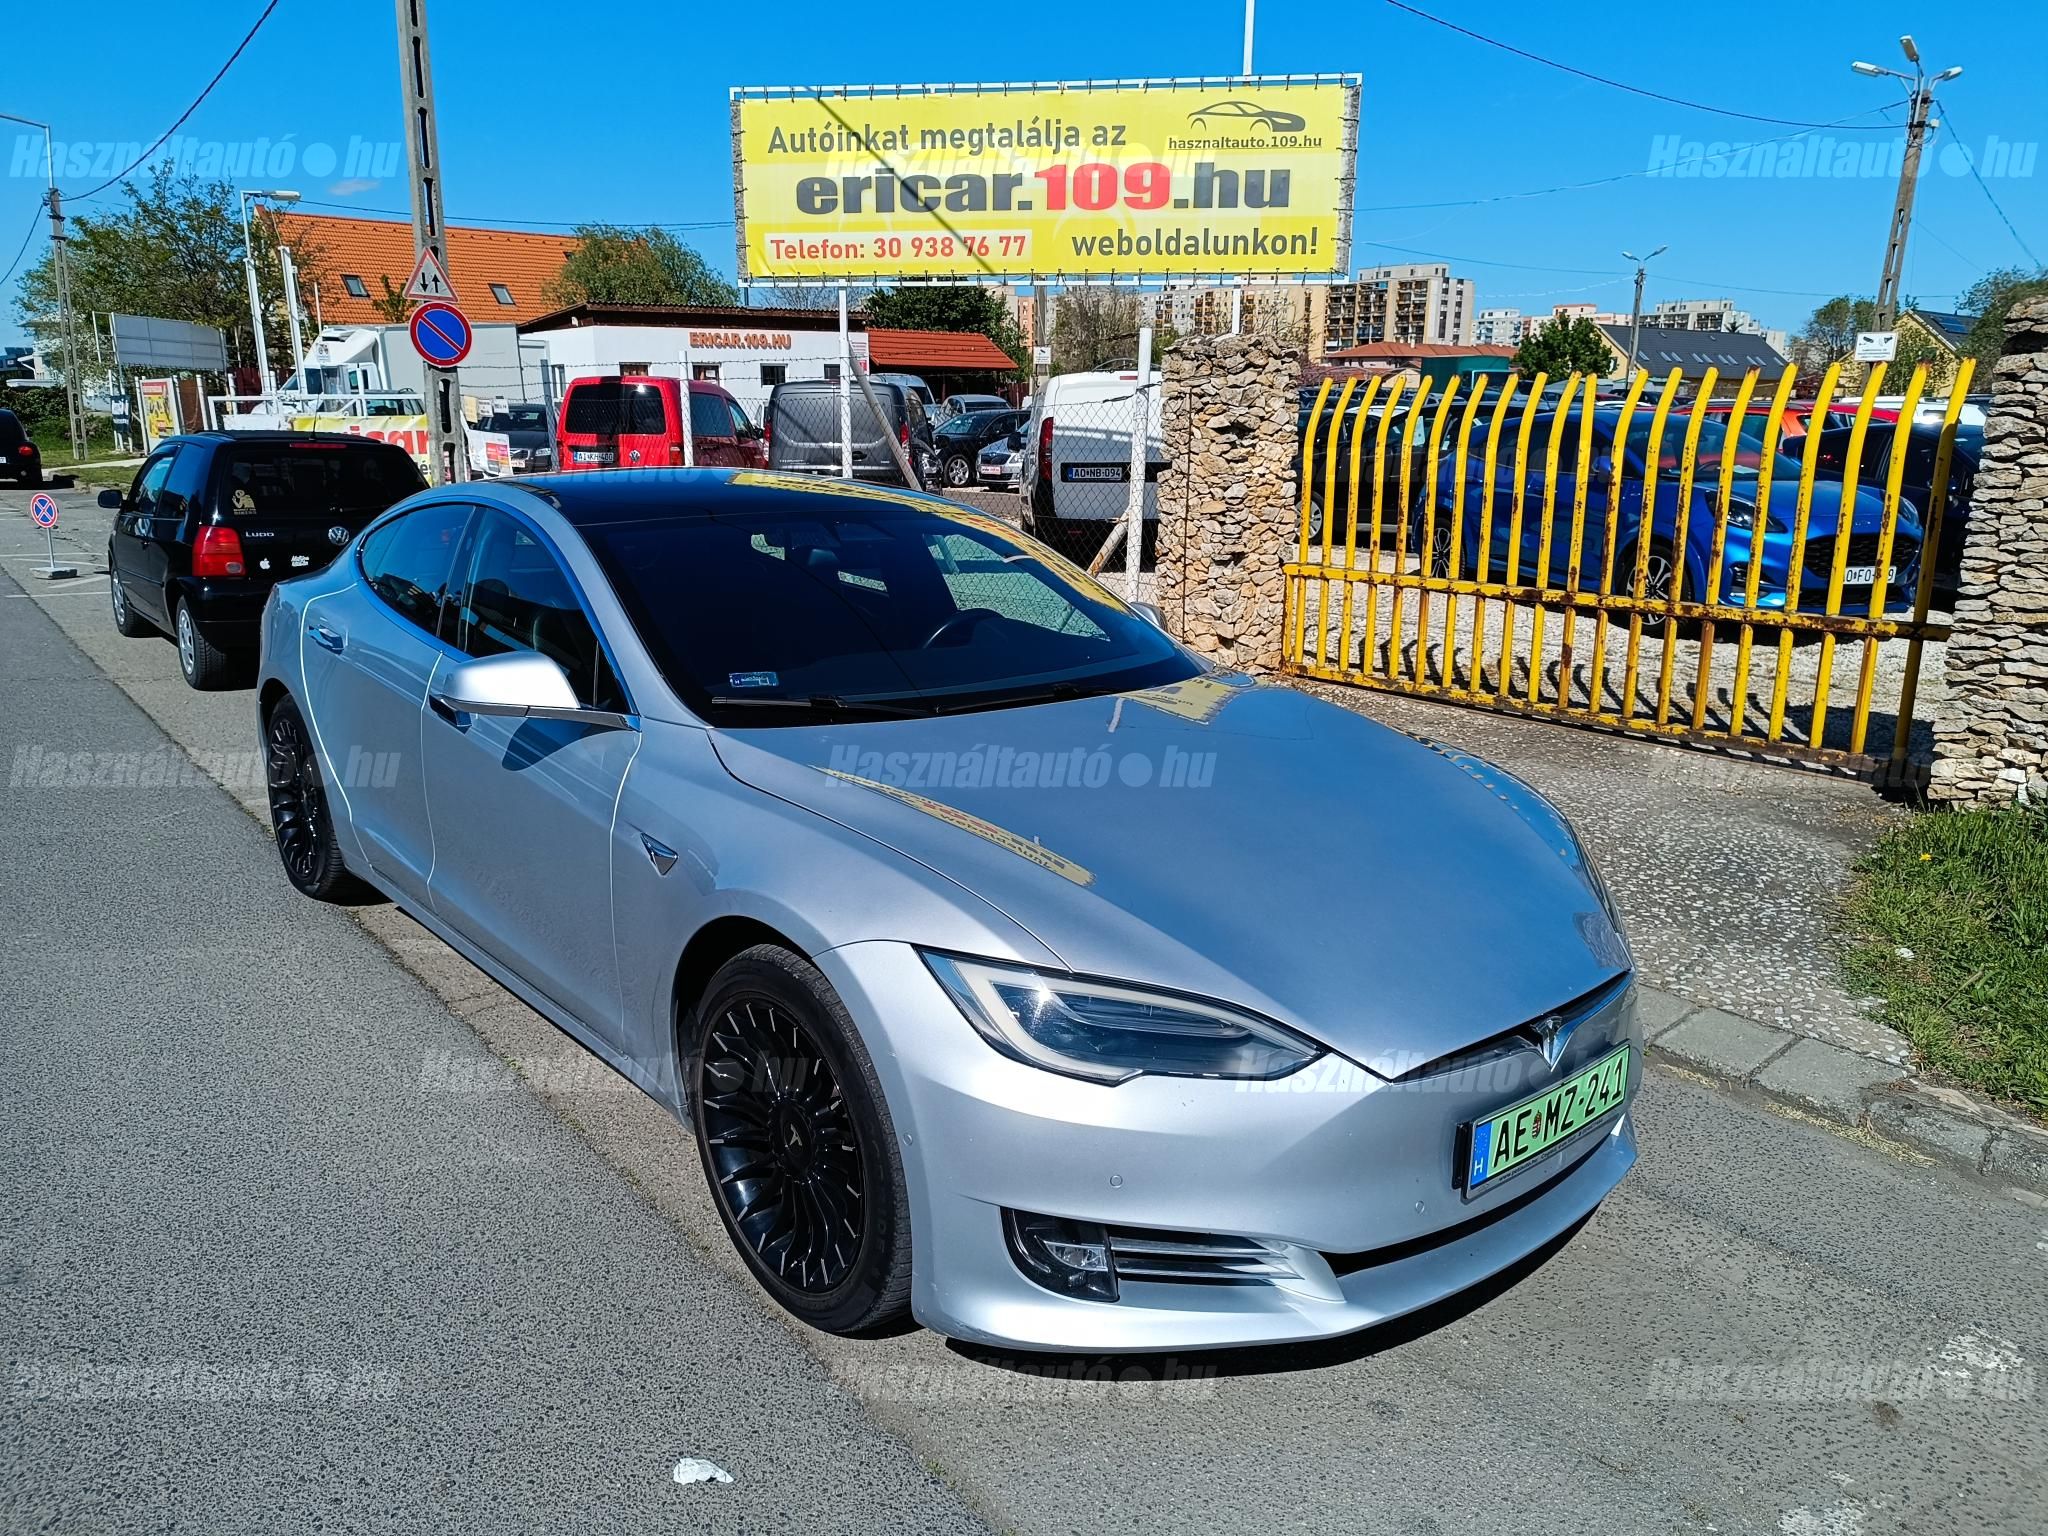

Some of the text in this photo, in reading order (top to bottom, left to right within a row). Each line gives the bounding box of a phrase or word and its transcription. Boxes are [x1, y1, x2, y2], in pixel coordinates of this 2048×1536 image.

[768, 116, 1127, 156] Autóinkat megtalálja az
[1168, 135, 1322, 149] hasznaltauto.109.hu
[796, 162, 1291, 216] ericar.109.hu
[770, 235, 1026, 260] Telefon: 30 938 76 77
[1072, 227, 1318, 258] weboldalunkon!
[689, 332, 792, 350] ERICAR.109.HU
[1493, 1108, 1532, 1168] AE
